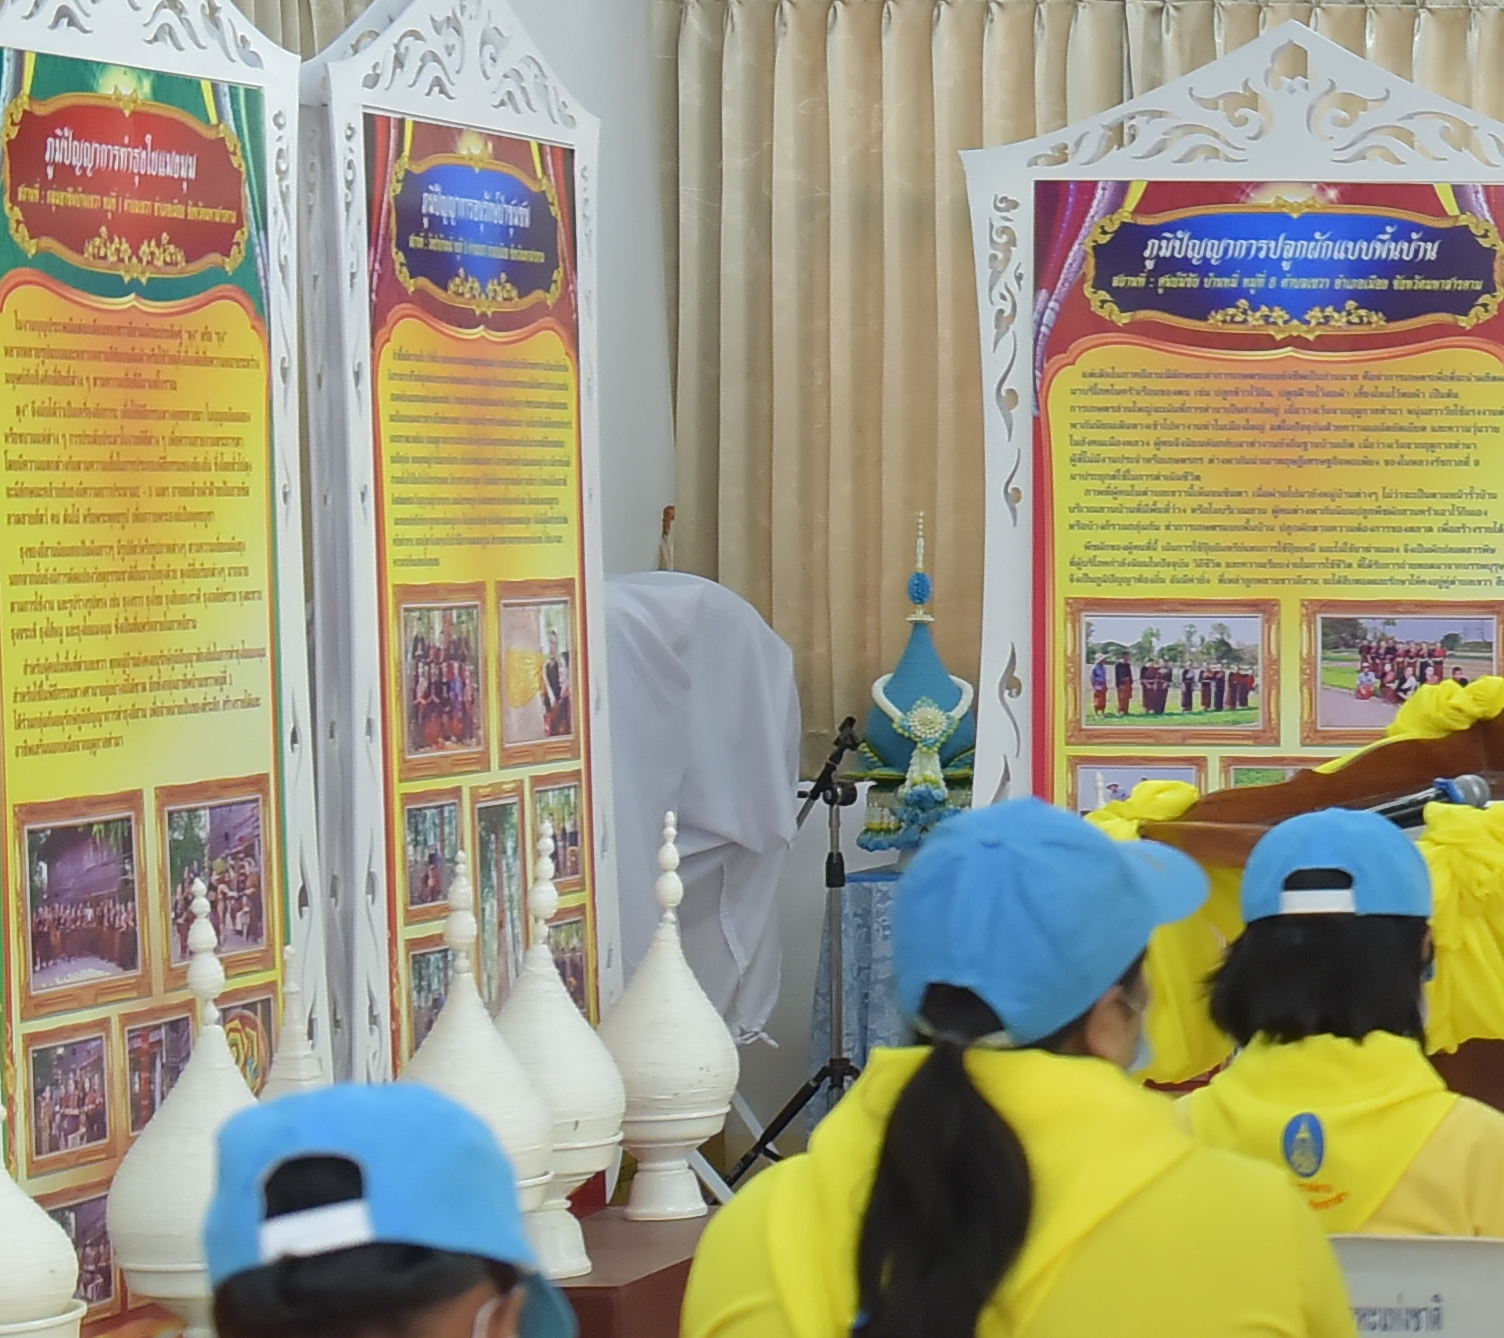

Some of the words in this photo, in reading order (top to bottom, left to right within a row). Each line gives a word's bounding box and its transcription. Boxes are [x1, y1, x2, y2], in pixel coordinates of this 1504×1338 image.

[1143, 226, 1439, 271] ภูมิปัญญาการปลูกผักแบบพื้นบ้าน
